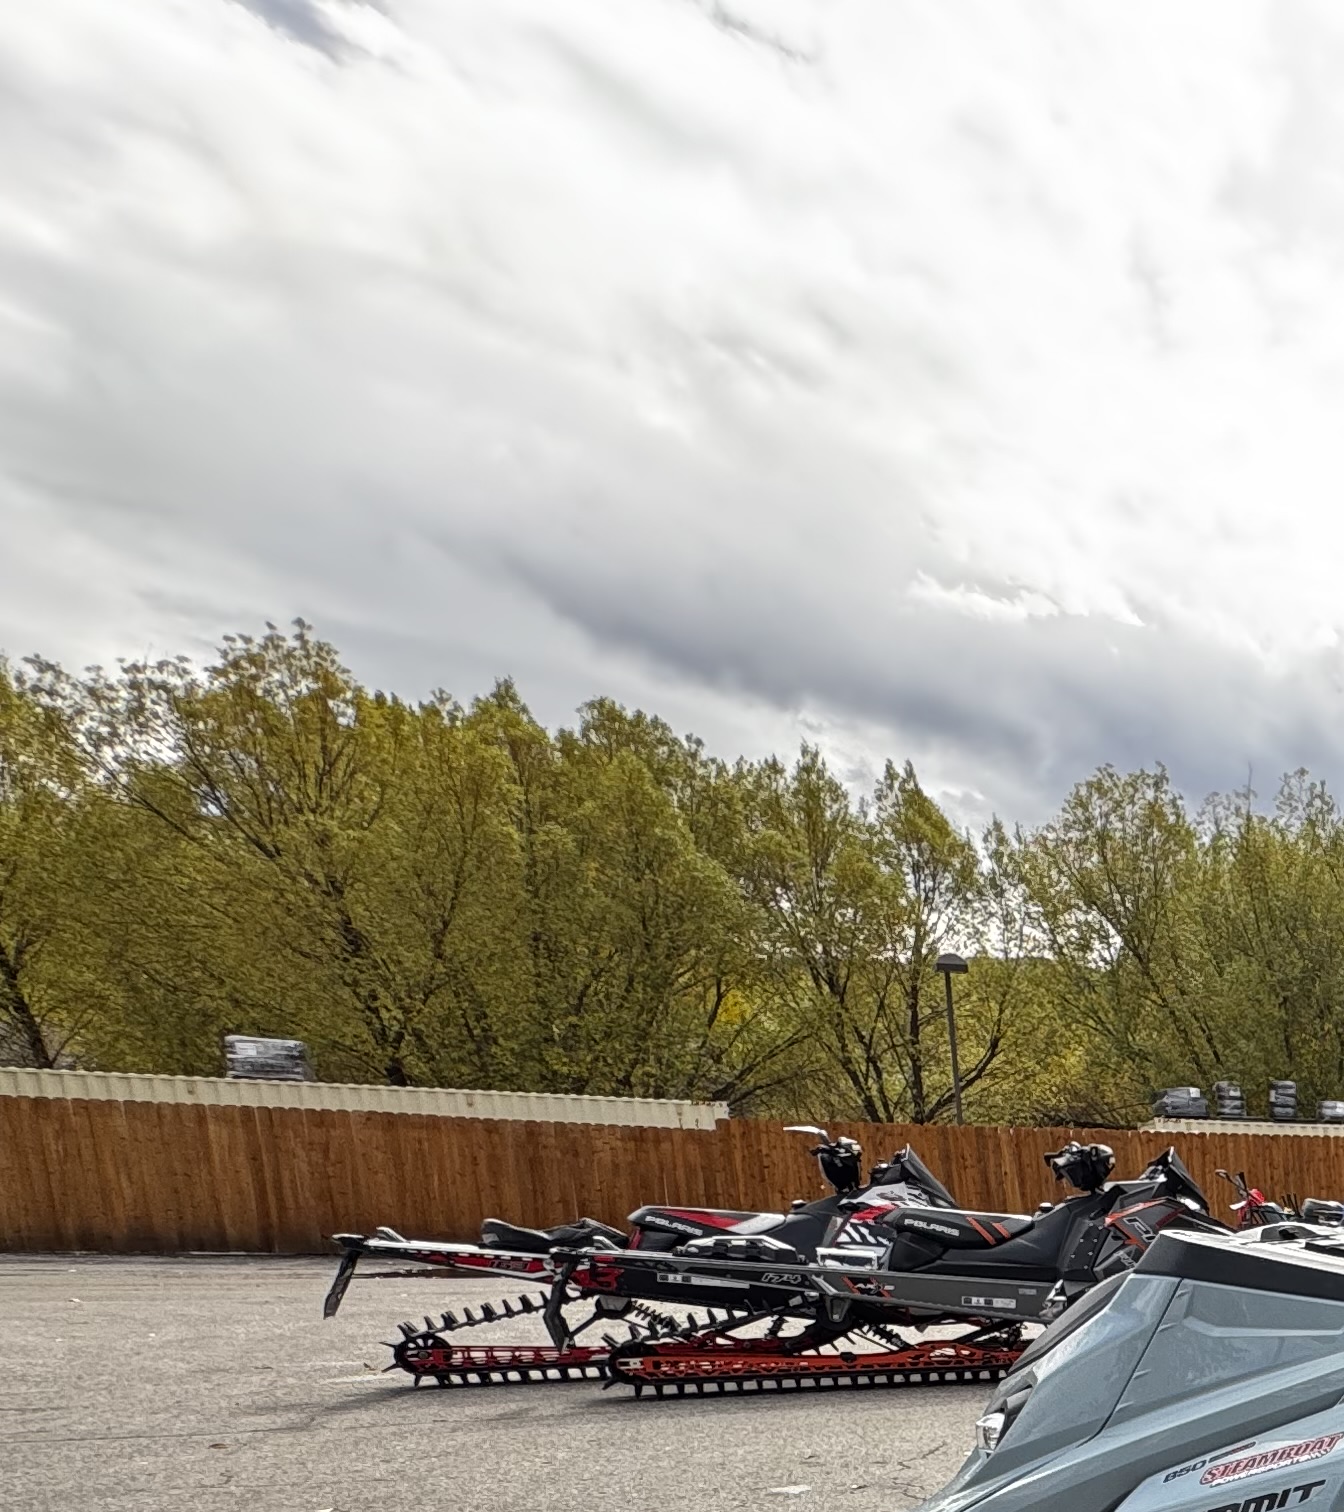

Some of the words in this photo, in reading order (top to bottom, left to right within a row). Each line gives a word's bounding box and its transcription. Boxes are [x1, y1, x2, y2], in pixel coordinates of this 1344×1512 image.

[645, 1215, 703, 1236] POLARIS
[903, 1218, 960, 1237] POLARIS
[1163, 1460, 1207, 1483] 850
